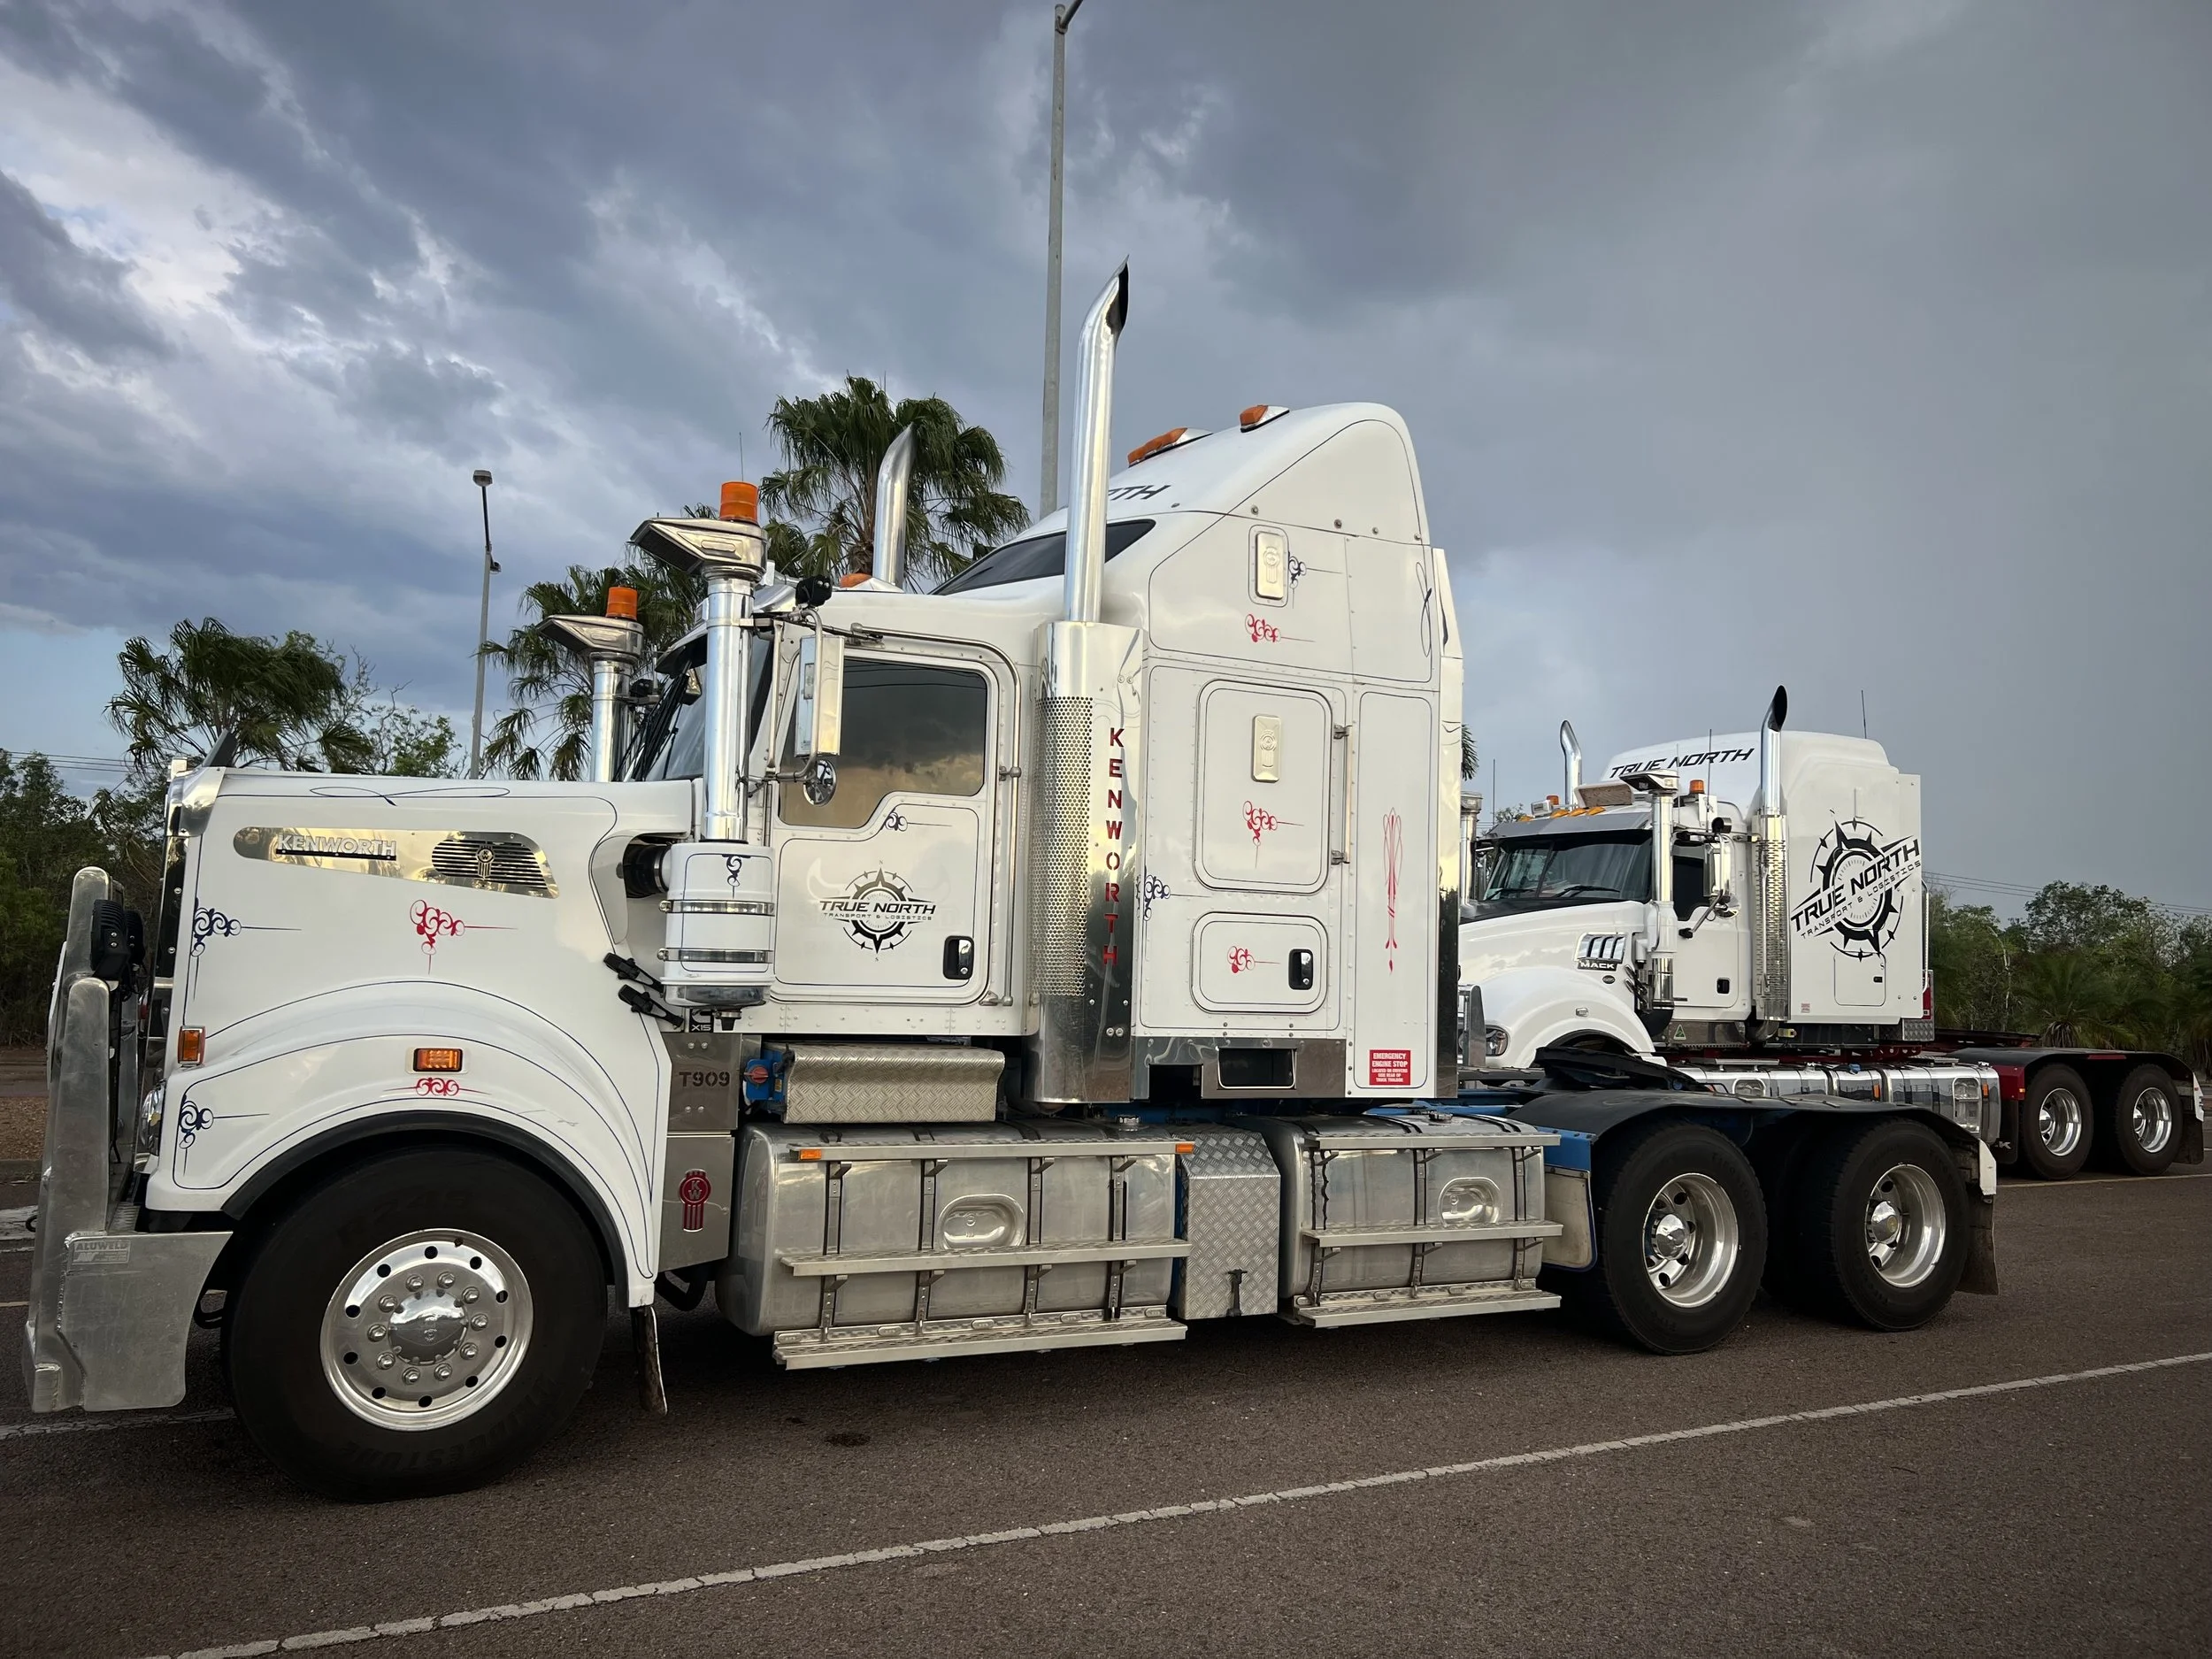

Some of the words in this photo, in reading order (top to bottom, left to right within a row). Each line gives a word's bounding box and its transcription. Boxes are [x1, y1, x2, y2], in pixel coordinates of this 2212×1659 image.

[1609, 758, 1667, 778] TRUE
[1668, 748, 1755, 768] NORTH
[277, 833, 396, 856] KENWORTH
[1102, 727, 1125, 967] KENWORTH
[1790, 883, 1847, 932] TRUE
[1850, 838, 1920, 896] NORTH
[819, 901, 870, 912] TRUE
[873, 902, 936, 915] NORTH
[1801, 902, 1853, 940] TRANSPORT
[1867, 860, 1921, 897] LOGISTICS
[1579, 960, 1615, 969] MACK
[679, 1071, 731, 1087] T909
[75, 1241, 127, 1250] ALUWELD
